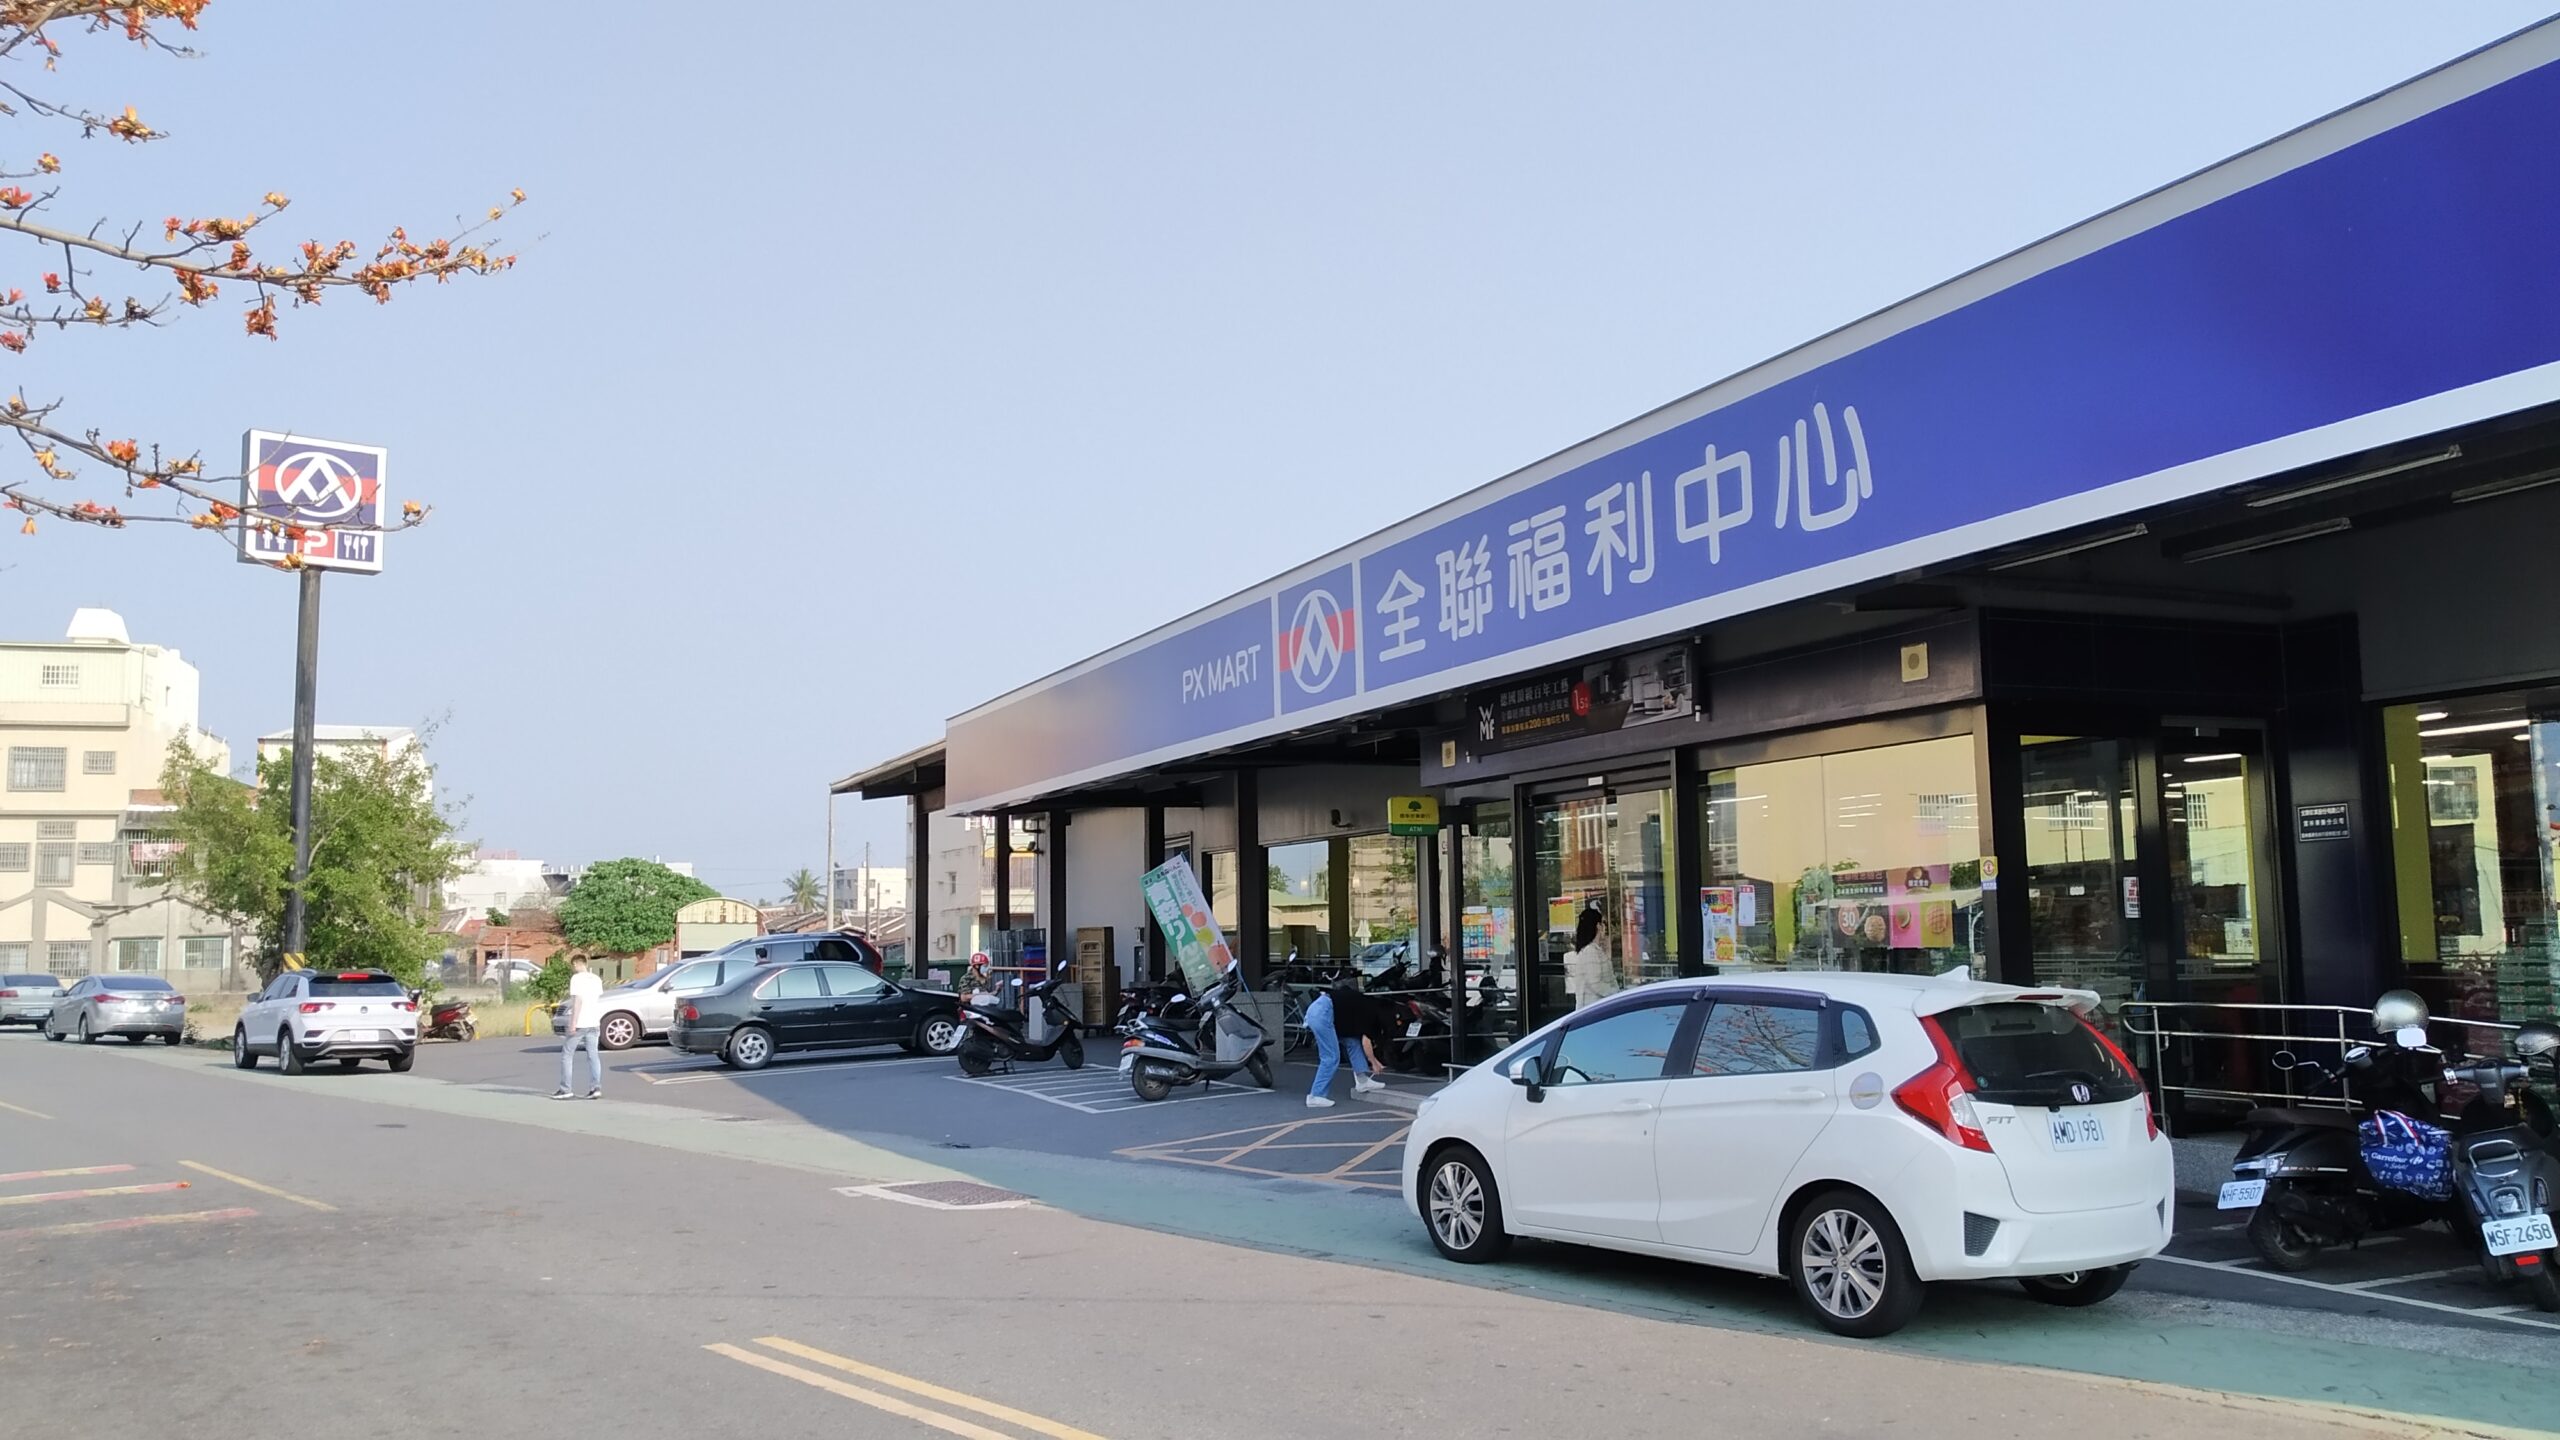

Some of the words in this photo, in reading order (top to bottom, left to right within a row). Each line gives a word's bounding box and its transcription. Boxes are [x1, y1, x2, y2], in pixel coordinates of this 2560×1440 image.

[1375, 402, 1874, 662] 全聯福利中心
[1183, 664, 1205, 704] PX
[1208, 644, 1261, 696] MART
[1842, 911, 1857, 928] 30
[1986, 1116, 2016, 1125] FIT
[2371, 1151, 2408, 1164] Carrefour
